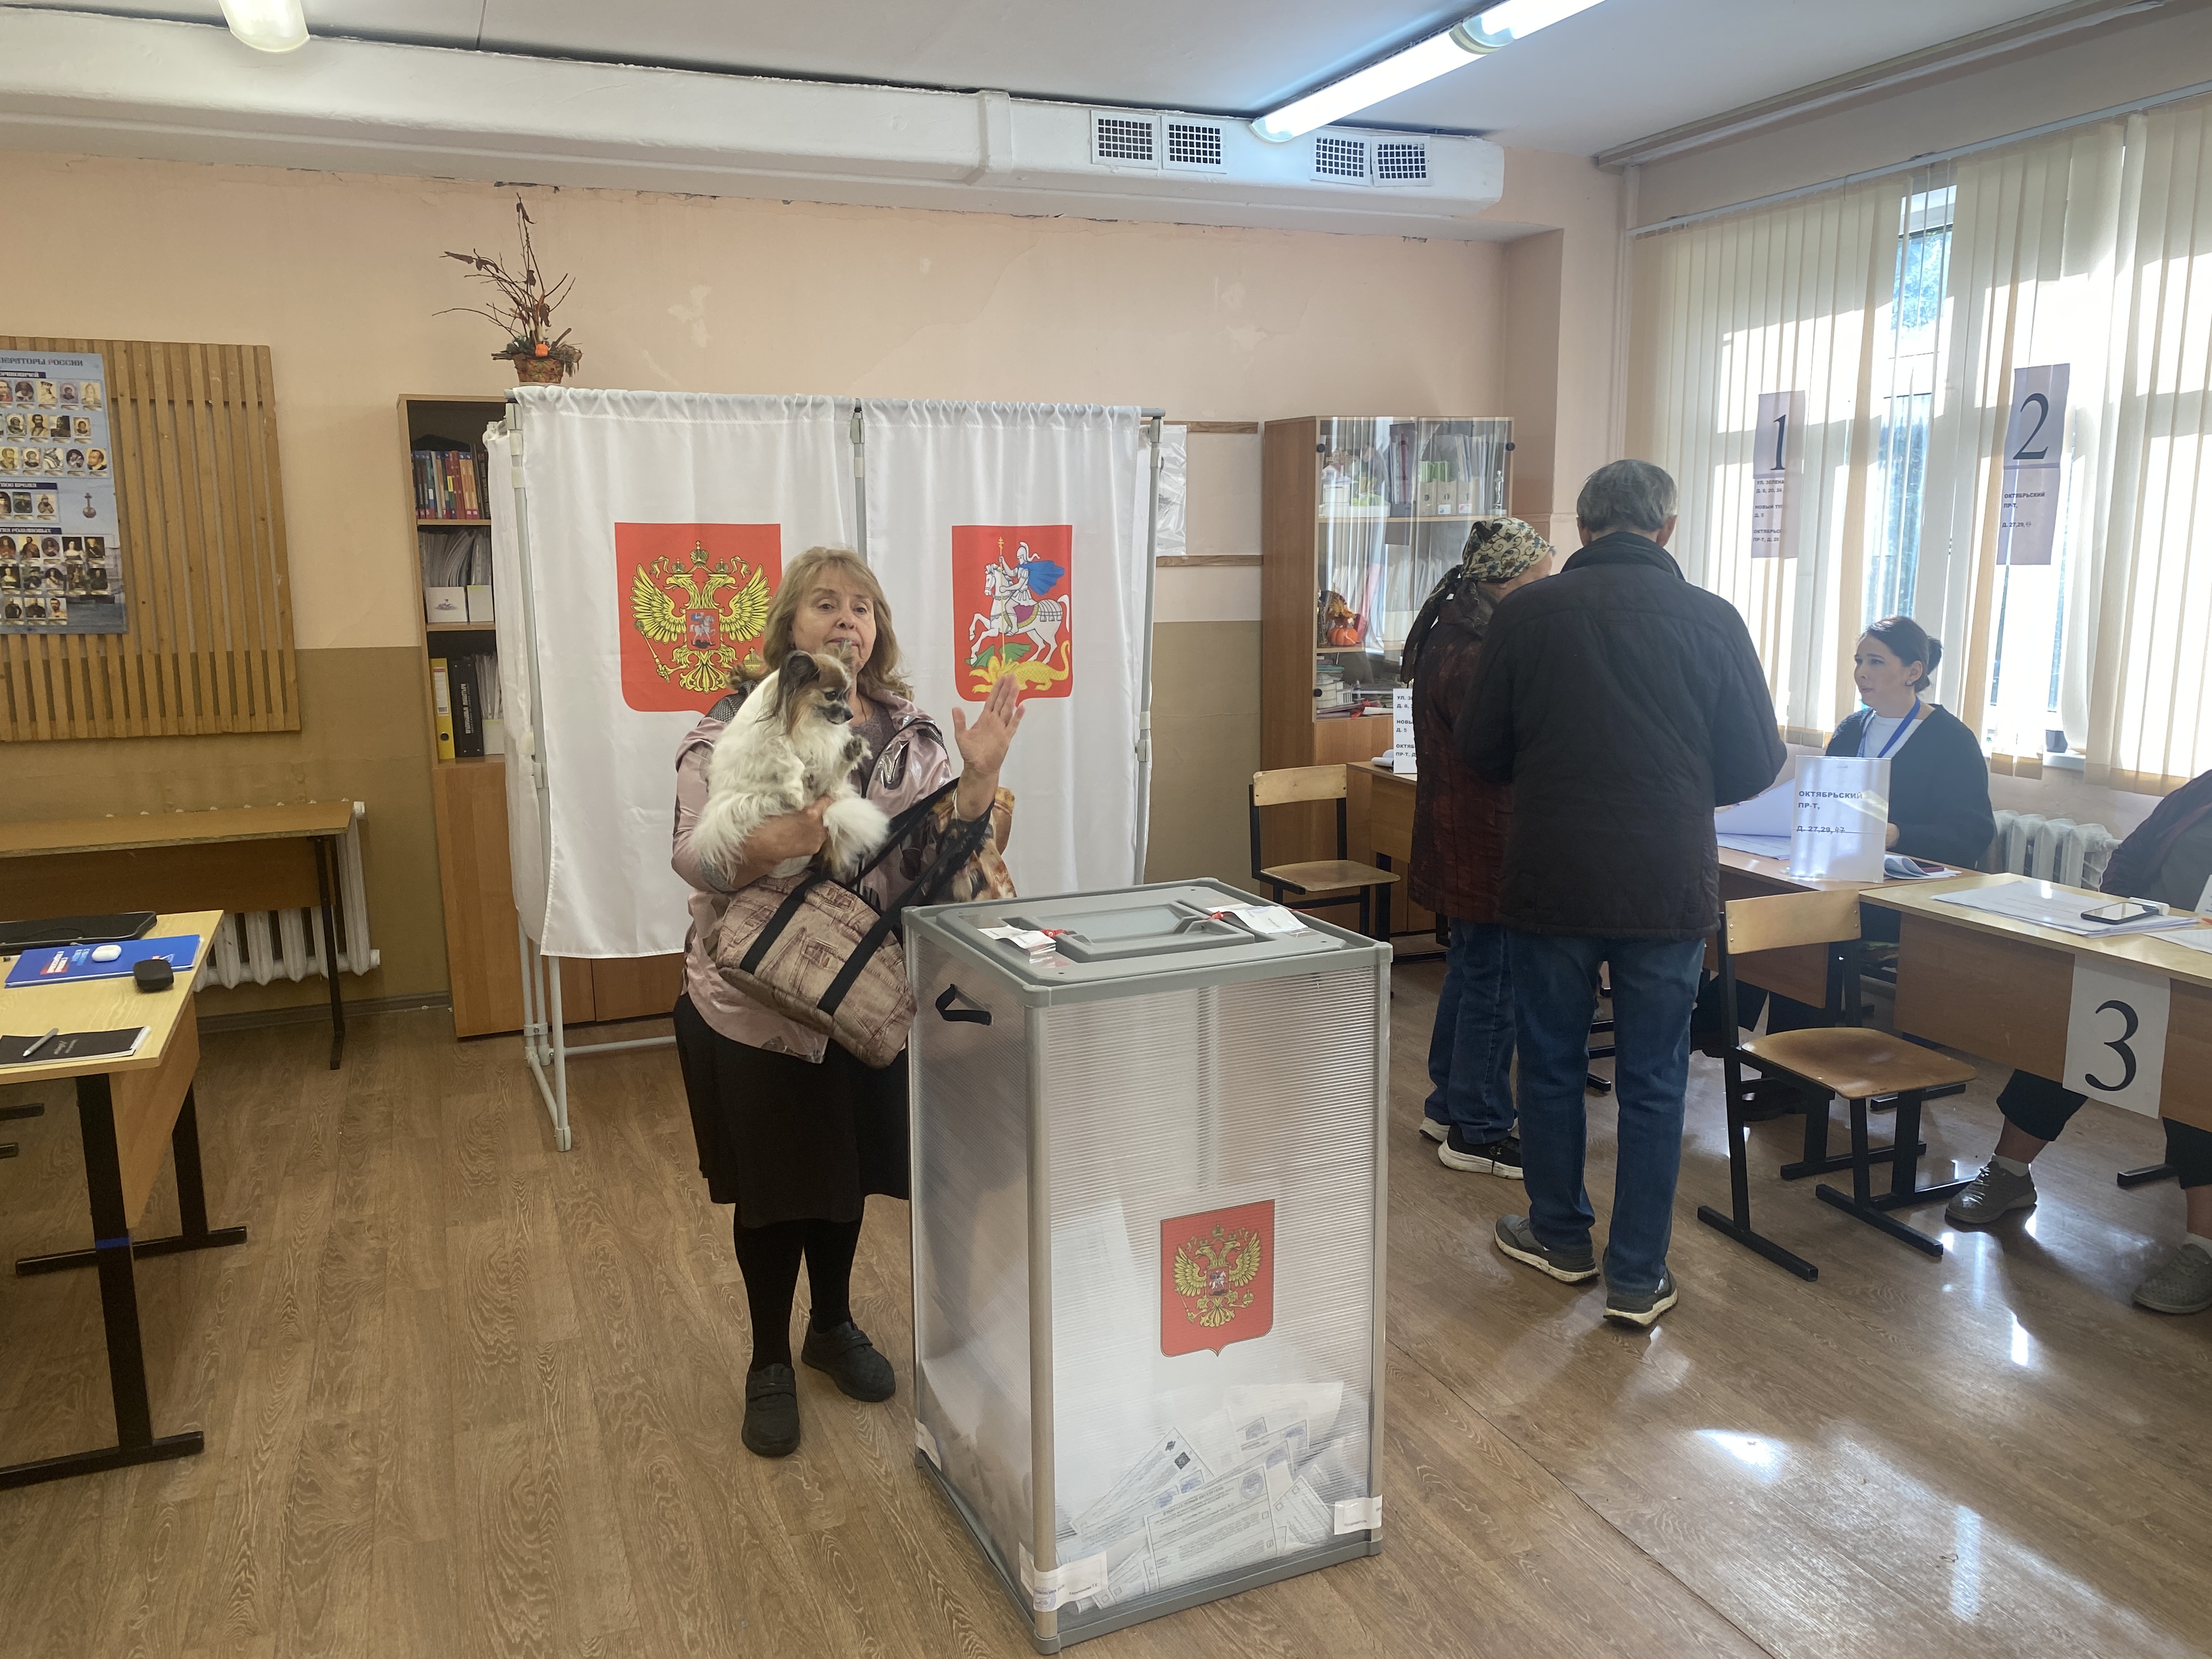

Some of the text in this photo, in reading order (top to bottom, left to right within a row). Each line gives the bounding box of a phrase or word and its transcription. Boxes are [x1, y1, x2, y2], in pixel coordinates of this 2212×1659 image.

[1770, 414, 1786, 470] 1
[2012, 393, 2049, 460] 2
[1798, 791, 1863, 799] ОКТЯБРЬСКИЙ
[2085, 1000, 2138, 1091] 3
